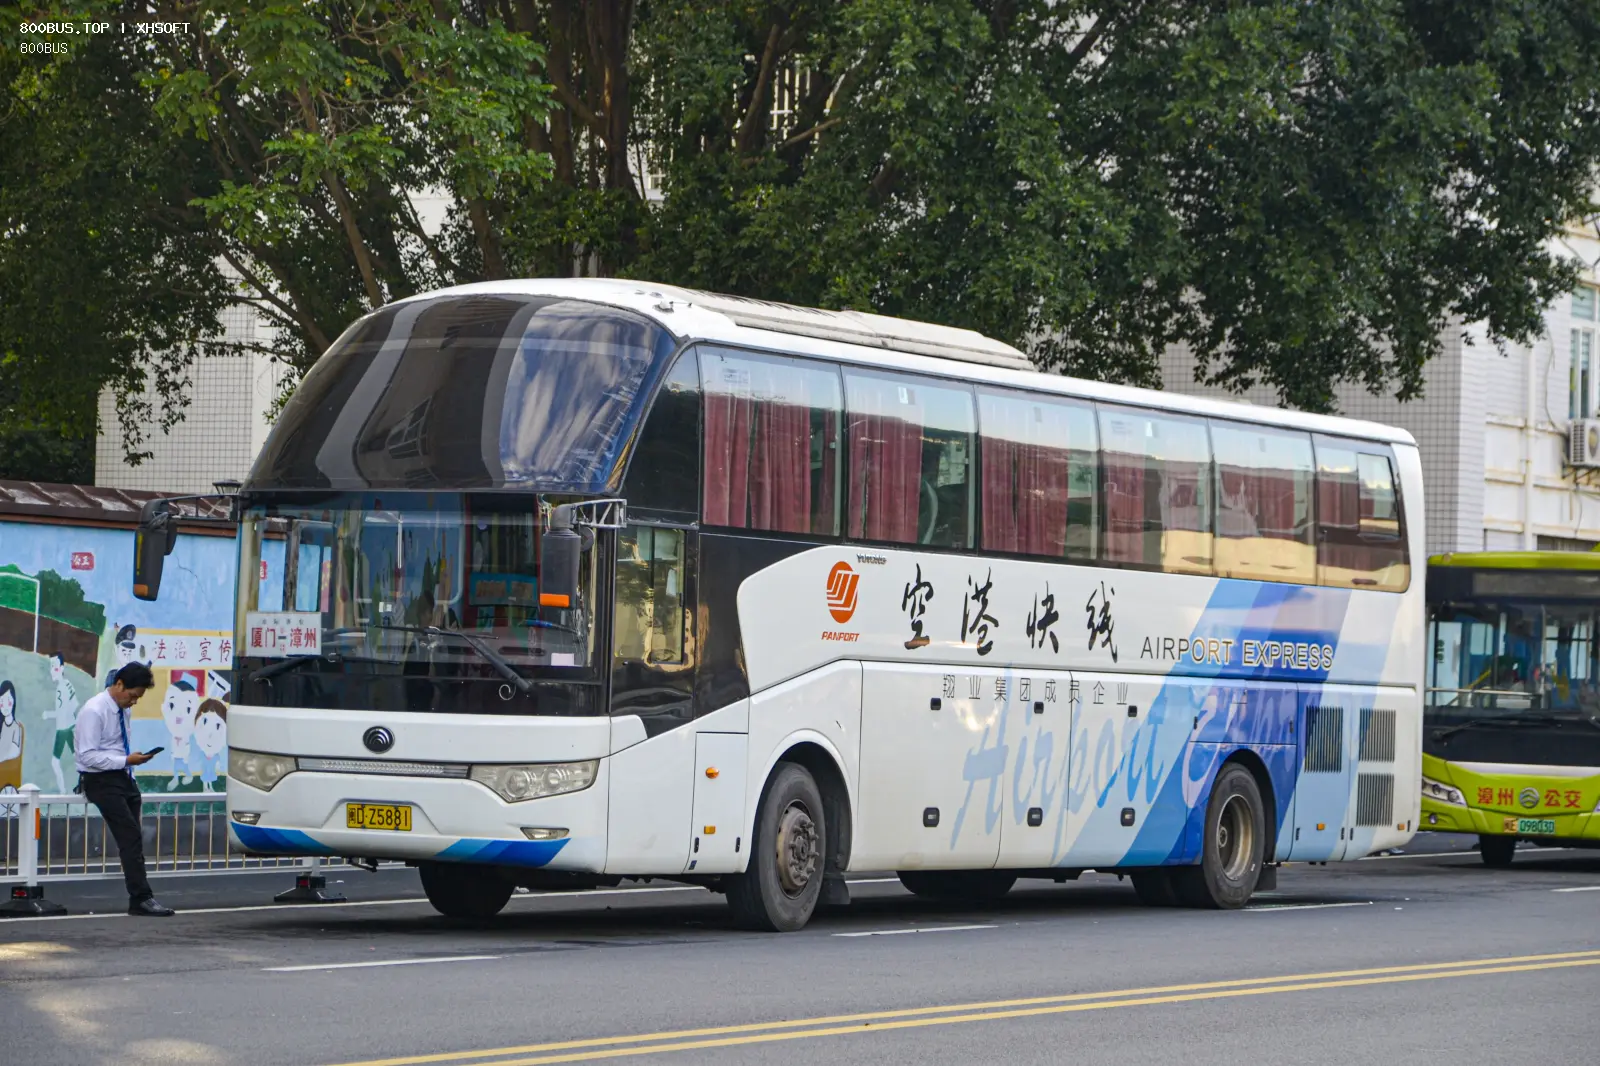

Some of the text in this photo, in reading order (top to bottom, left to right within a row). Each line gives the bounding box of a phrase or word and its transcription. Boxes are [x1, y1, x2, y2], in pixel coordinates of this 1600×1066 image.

[901, 563, 1118, 663] 空港快线
[152, 637, 232, 663] 法治宣传
[1140, 636, 1335, 671] AIRPORT EXPRESS
[942, 674, 1129, 705] 翔业集团成员企业
[1477, 786, 1582, 809] 漳州 公交
